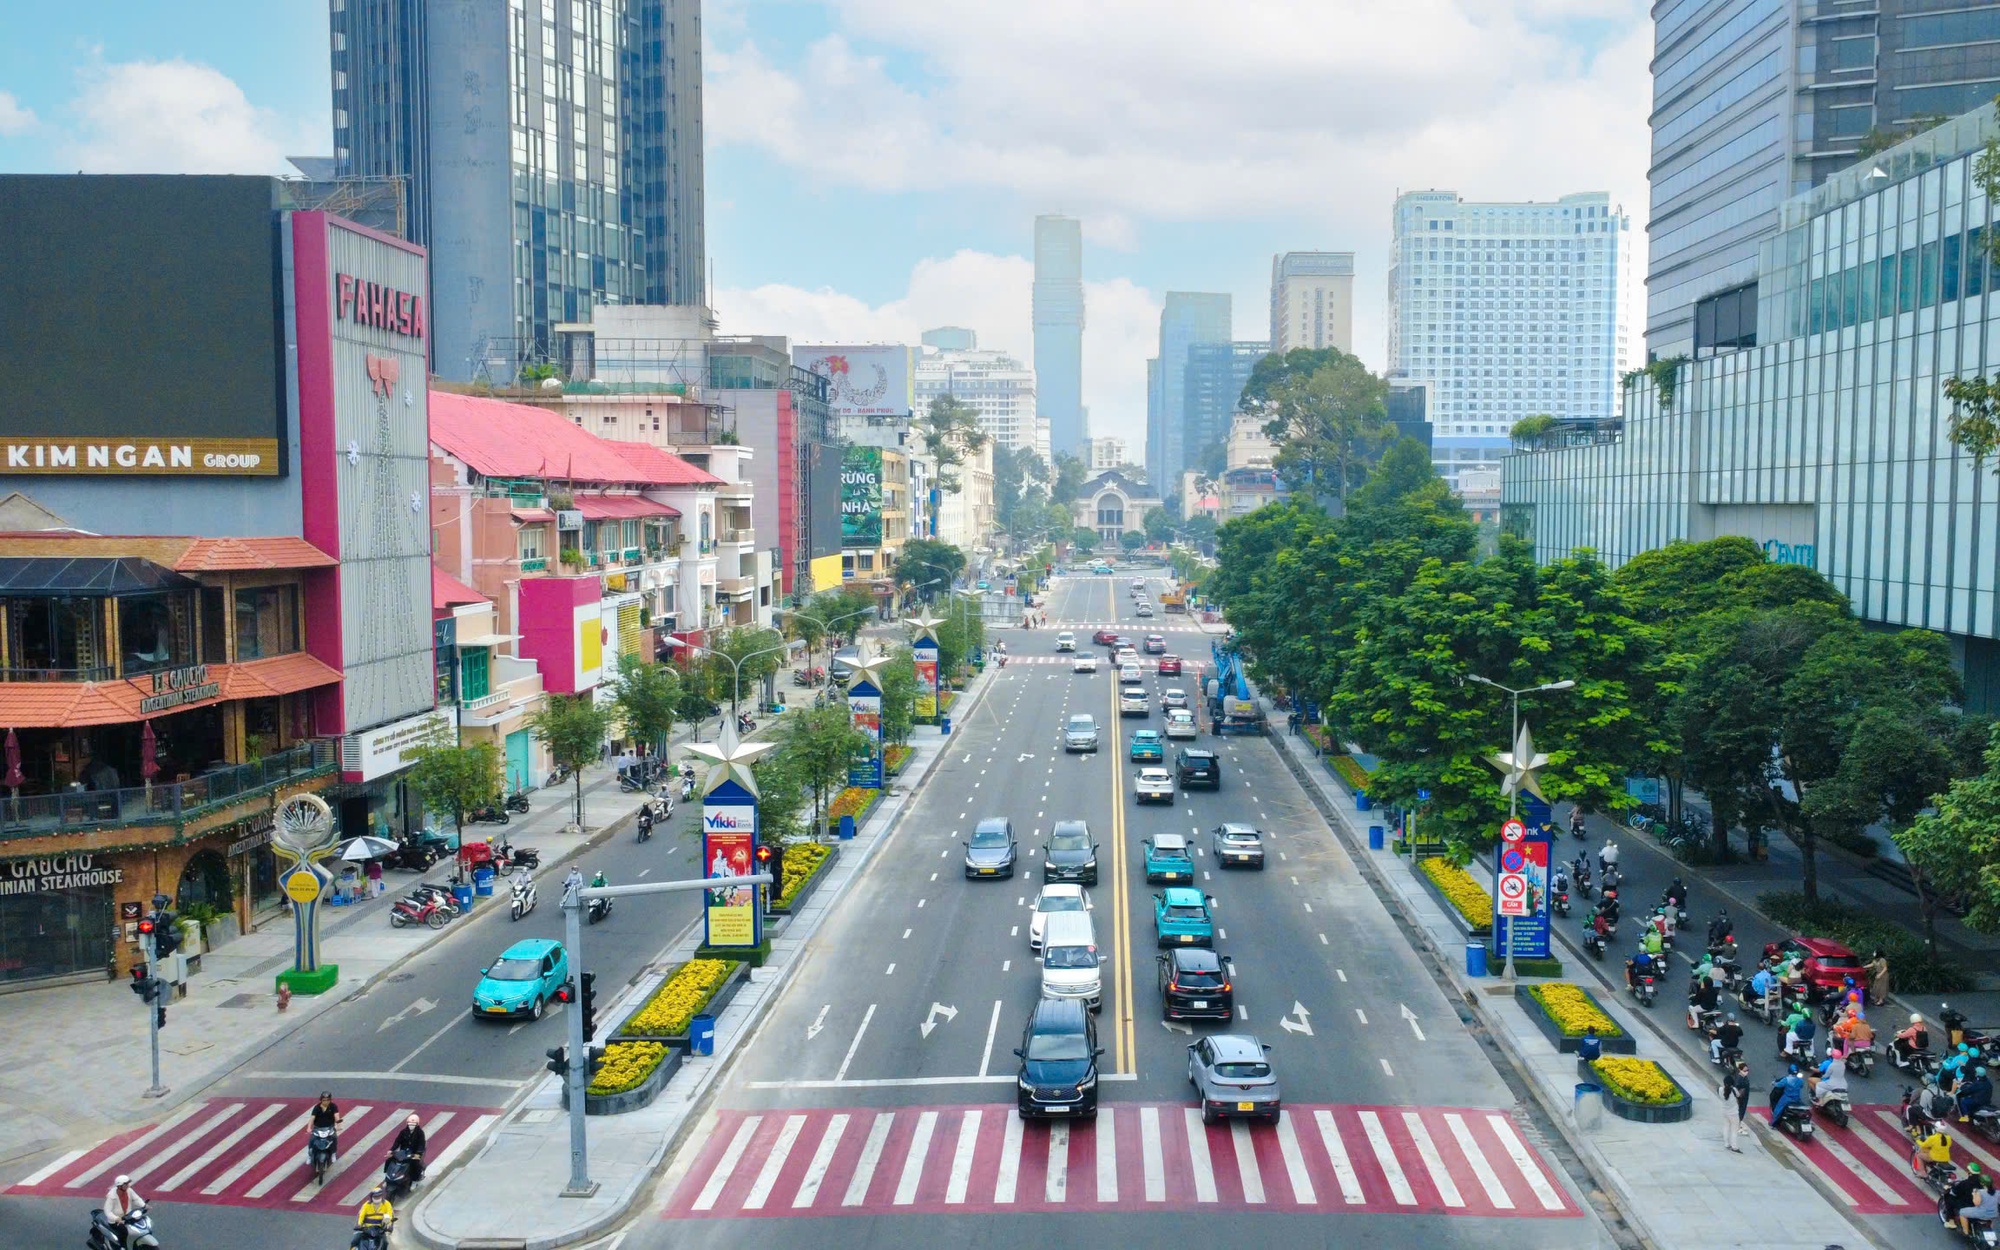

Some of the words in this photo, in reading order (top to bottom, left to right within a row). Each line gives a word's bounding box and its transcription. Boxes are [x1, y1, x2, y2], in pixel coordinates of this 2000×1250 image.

[336, 273, 425, 338] FAHASA
[8, 445, 76, 467] KIM
[87, 445, 192, 467] NGAN
[203, 453, 260, 468] GROUP
[842, 500, 872, 513] NHÀ
[153, 673, 168, 693] EL
[169, 664, 208, 689] GAUCHO
[705, 811, 737, 828] Vikki
[11, 854, 92, 878] GAUCHO
[41, 869, 123, 891] STEAKHOUSE
